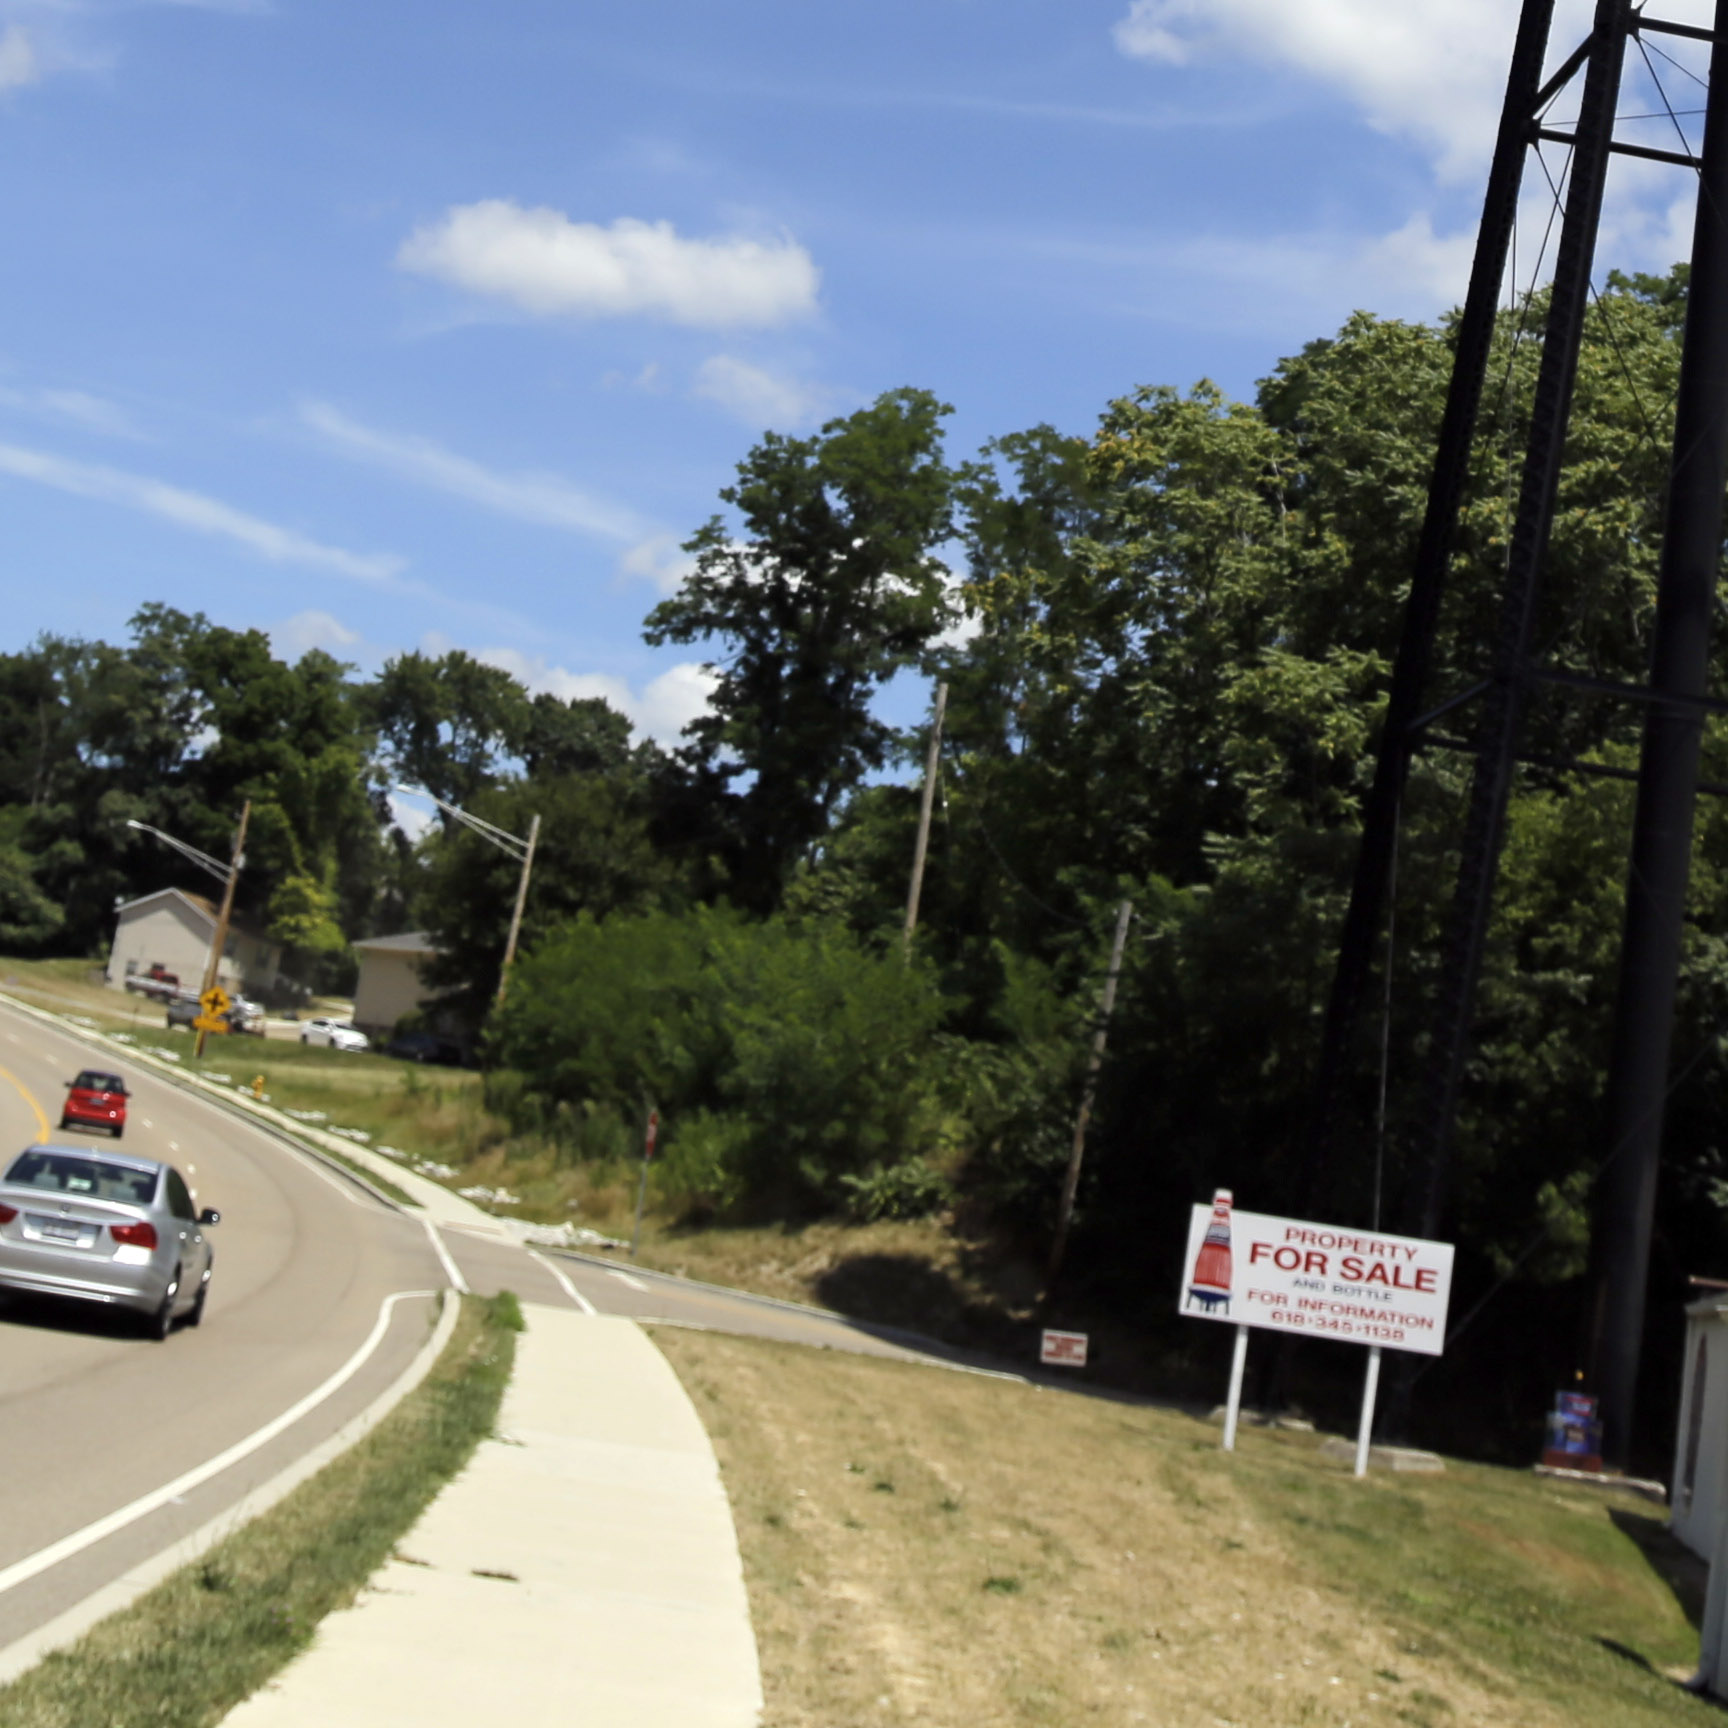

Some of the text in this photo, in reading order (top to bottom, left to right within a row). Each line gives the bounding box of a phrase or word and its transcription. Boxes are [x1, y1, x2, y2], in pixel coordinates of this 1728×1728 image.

[1285, 1226, 1419, 1261] PROPERTY
[1249, 1242, 1439, 1294] FOR SALE
[1247, 1288, 1434, 1330] FOR INFORMATION
[1293, 1278, 1394, 1303] AND BOTTLE
